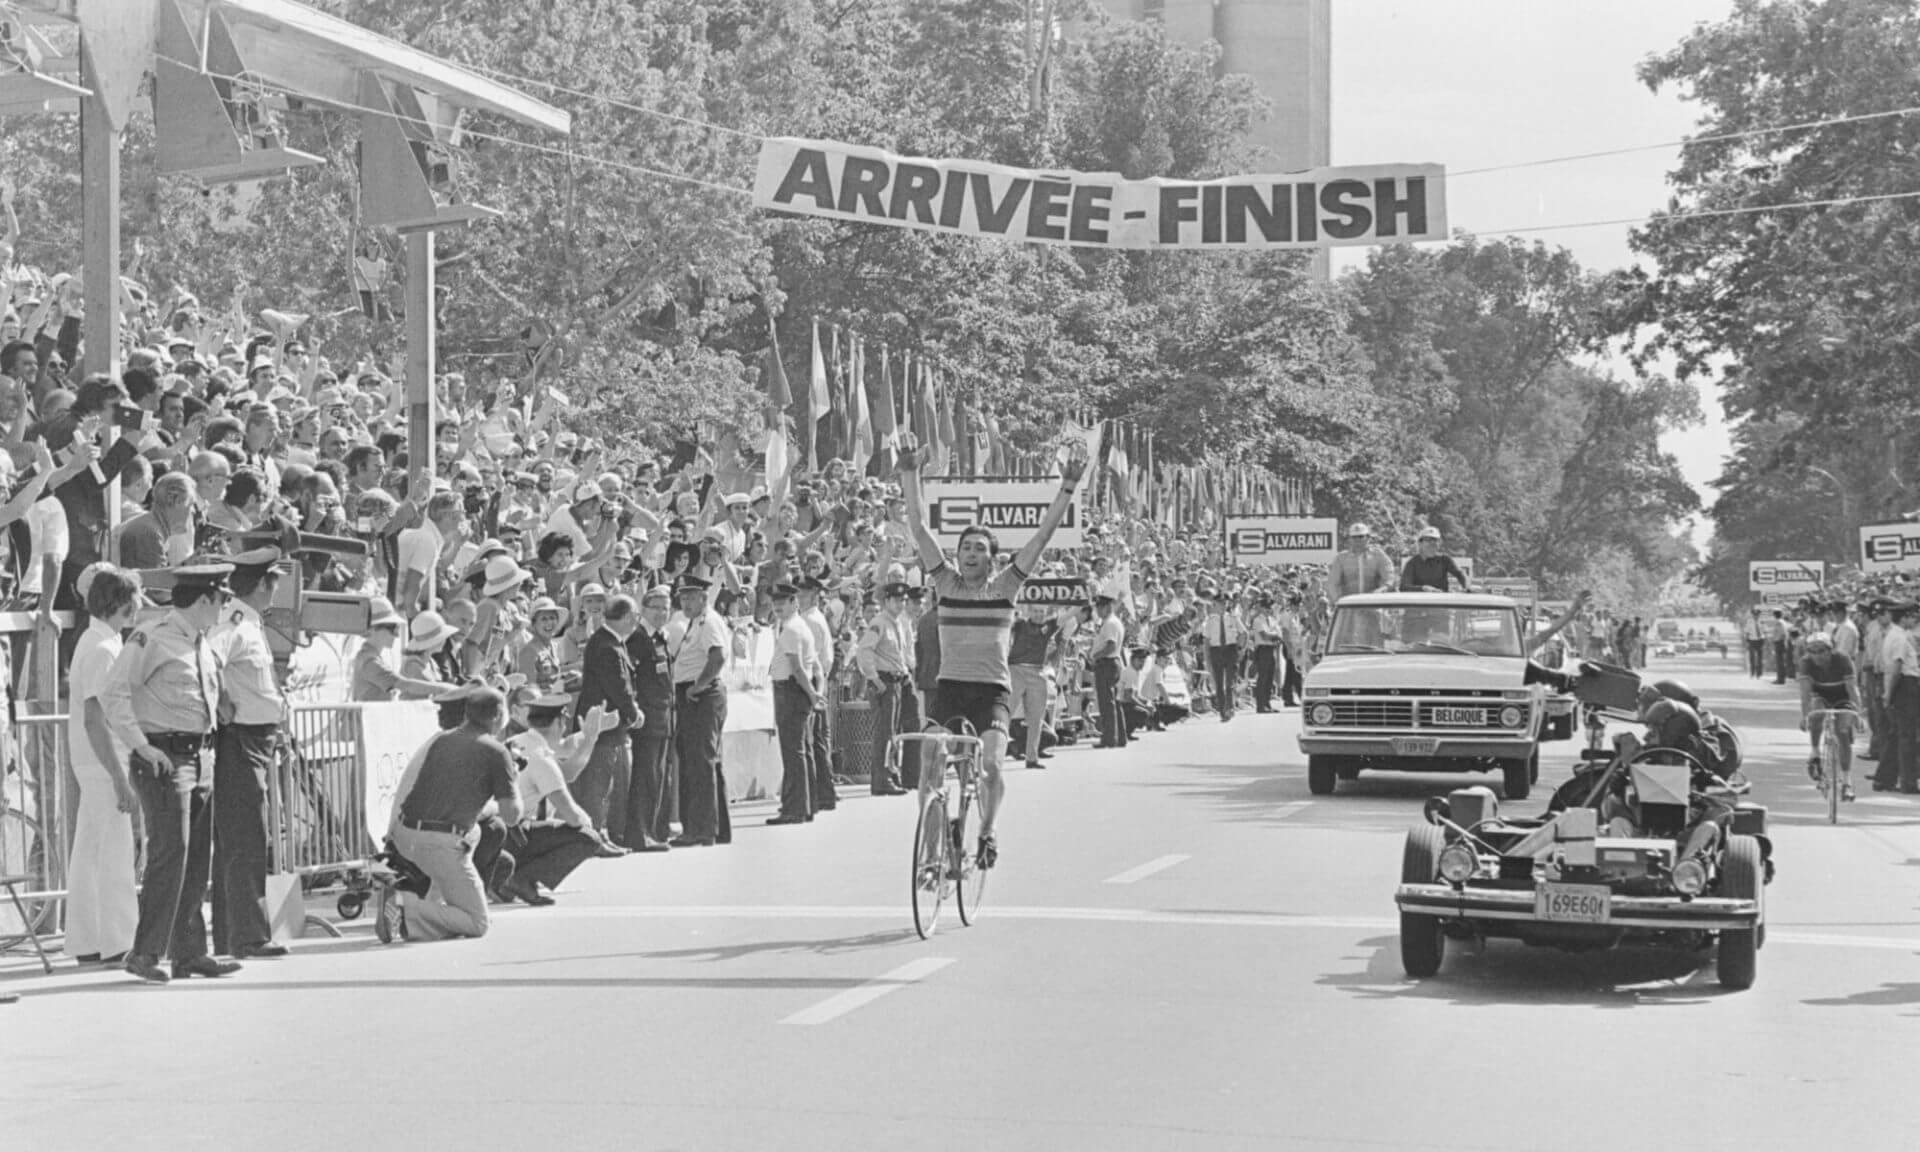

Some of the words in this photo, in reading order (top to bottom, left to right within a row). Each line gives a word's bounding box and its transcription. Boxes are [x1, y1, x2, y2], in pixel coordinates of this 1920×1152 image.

[1159, 176, 1427, 244] FINISH
[940, 498, 1068, 533] SALVARAI
[1238, 530, 1328, 553] SALVARANI
[1873, 537, 1920, 560] SAL
[1435, 709, 1484, 723] BELGIQUE
